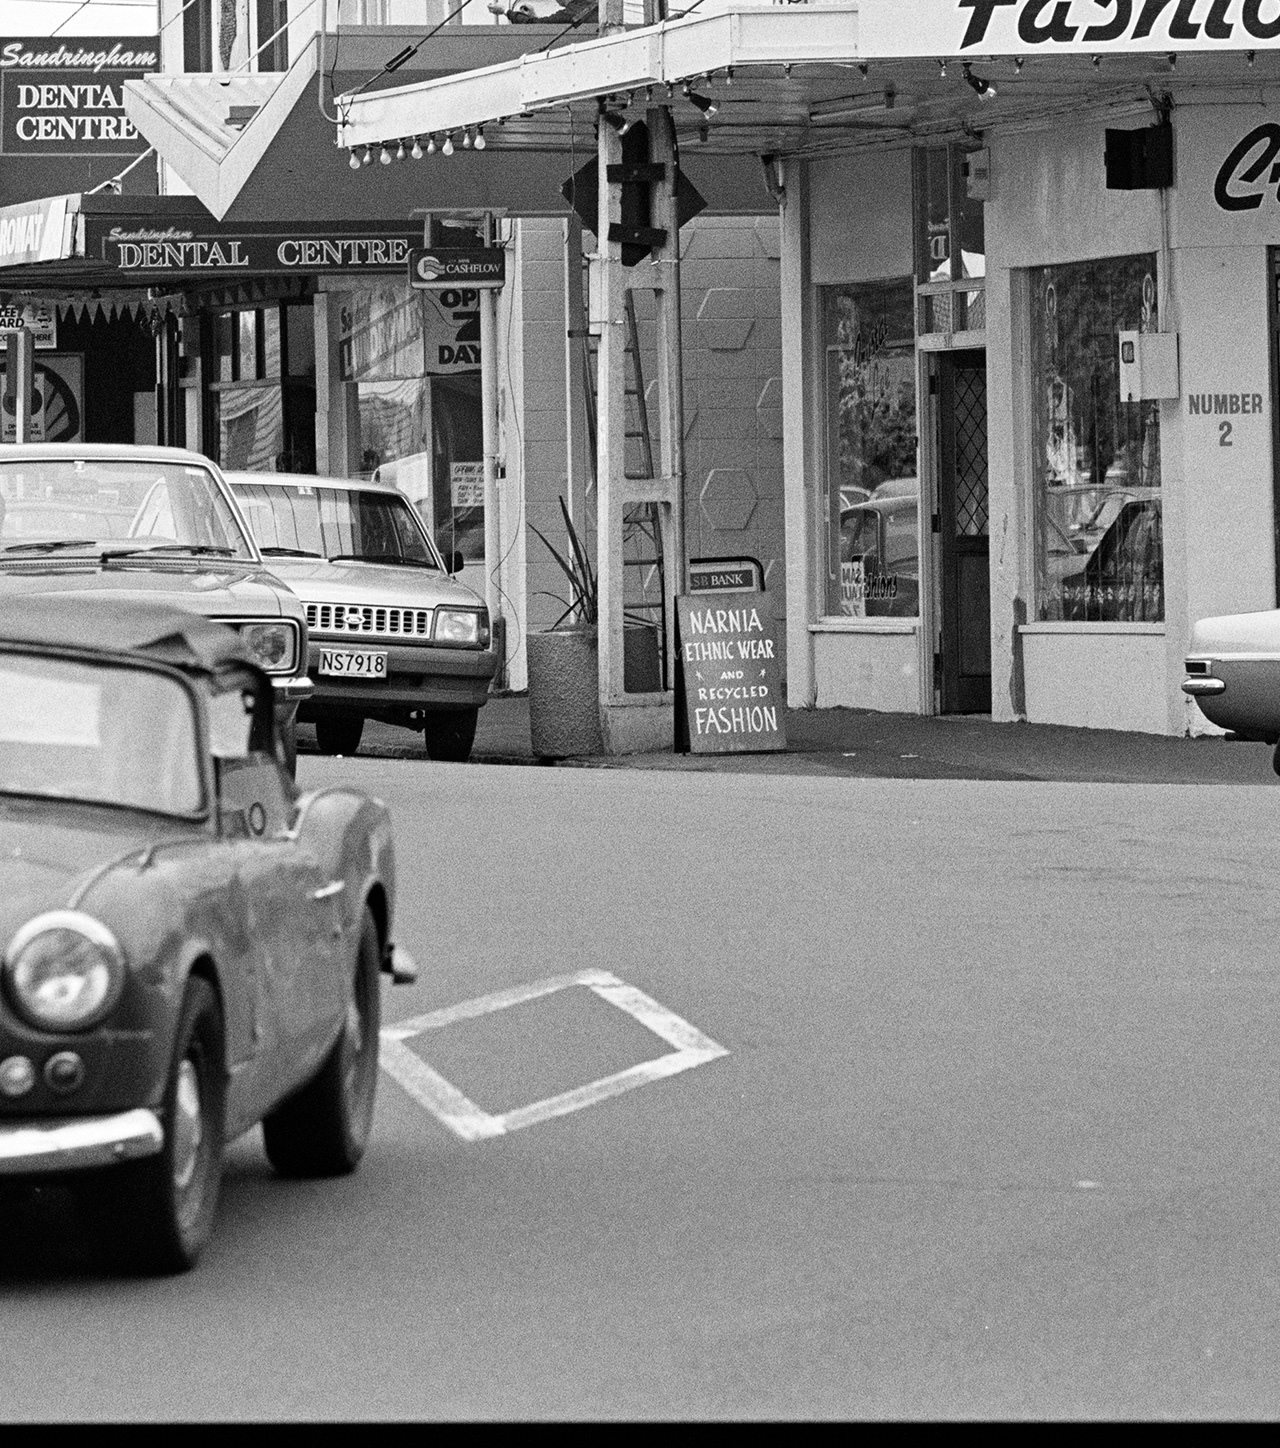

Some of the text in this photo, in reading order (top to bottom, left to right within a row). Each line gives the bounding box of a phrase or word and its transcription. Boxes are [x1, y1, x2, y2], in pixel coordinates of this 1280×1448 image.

[0, 42, 158, 73] Sandringham
[16, 115, 138, 141] CENTRE
[108, 226, 194, 243] Sandringham
[117, 238, 412, 268] DENTAL CENTRE
[446, 263, 502, 274] CASHFLOW
[439, 290, 477, 308] OP
[438, 344, 481, 365] DAY
[1188, 393, 1263, 414] NUMBER
[1219, 420, 1233, 447] 2
[690, 573, 743, 587] SB BANK
[689, 608, 764, 634] NARNIA
[685, 639, 775, 662] ETHNIC WEAR
[322, 653, 384, 673] NS7918
[720, 670, 744, 680] AND
[698, 686, 768, 701] RECYCLED
[694, 706, 778, 735] FASHION
